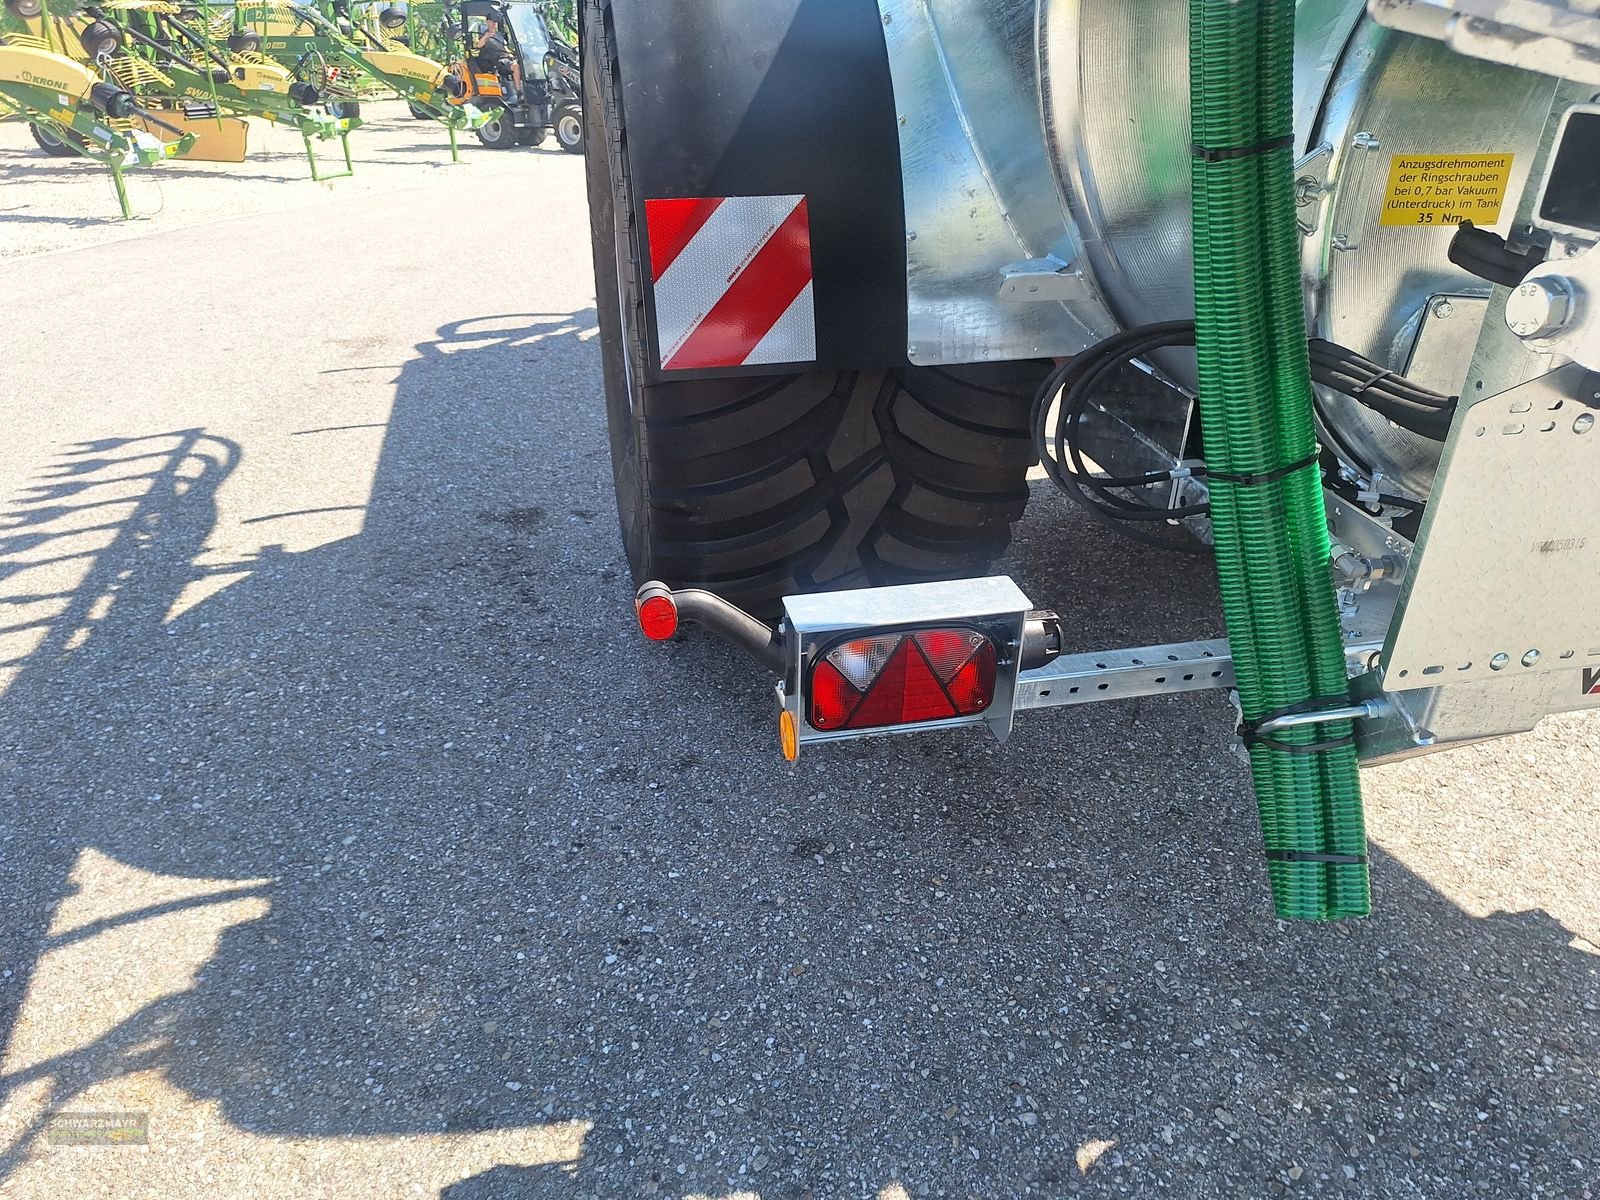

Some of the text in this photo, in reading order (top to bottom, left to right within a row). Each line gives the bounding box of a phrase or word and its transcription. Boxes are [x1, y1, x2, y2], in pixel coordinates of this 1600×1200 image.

[263, 74, 282, 82] KRONE
[408, 71, 430, 80] KRONE
[32, 75, 69, 91] KRONE
[1398, 159, 1505, 171] Anzugsdrehmoment
[1399, 172, 1499, 184] der Ringschrauben
[1394, 186, 1498, 197] bei 0,7 bar Vakuum
[1387, 198, 1500, 210] (Unterdruck) im Tank
[1416, 212, 1463, 223] 35 Nm
